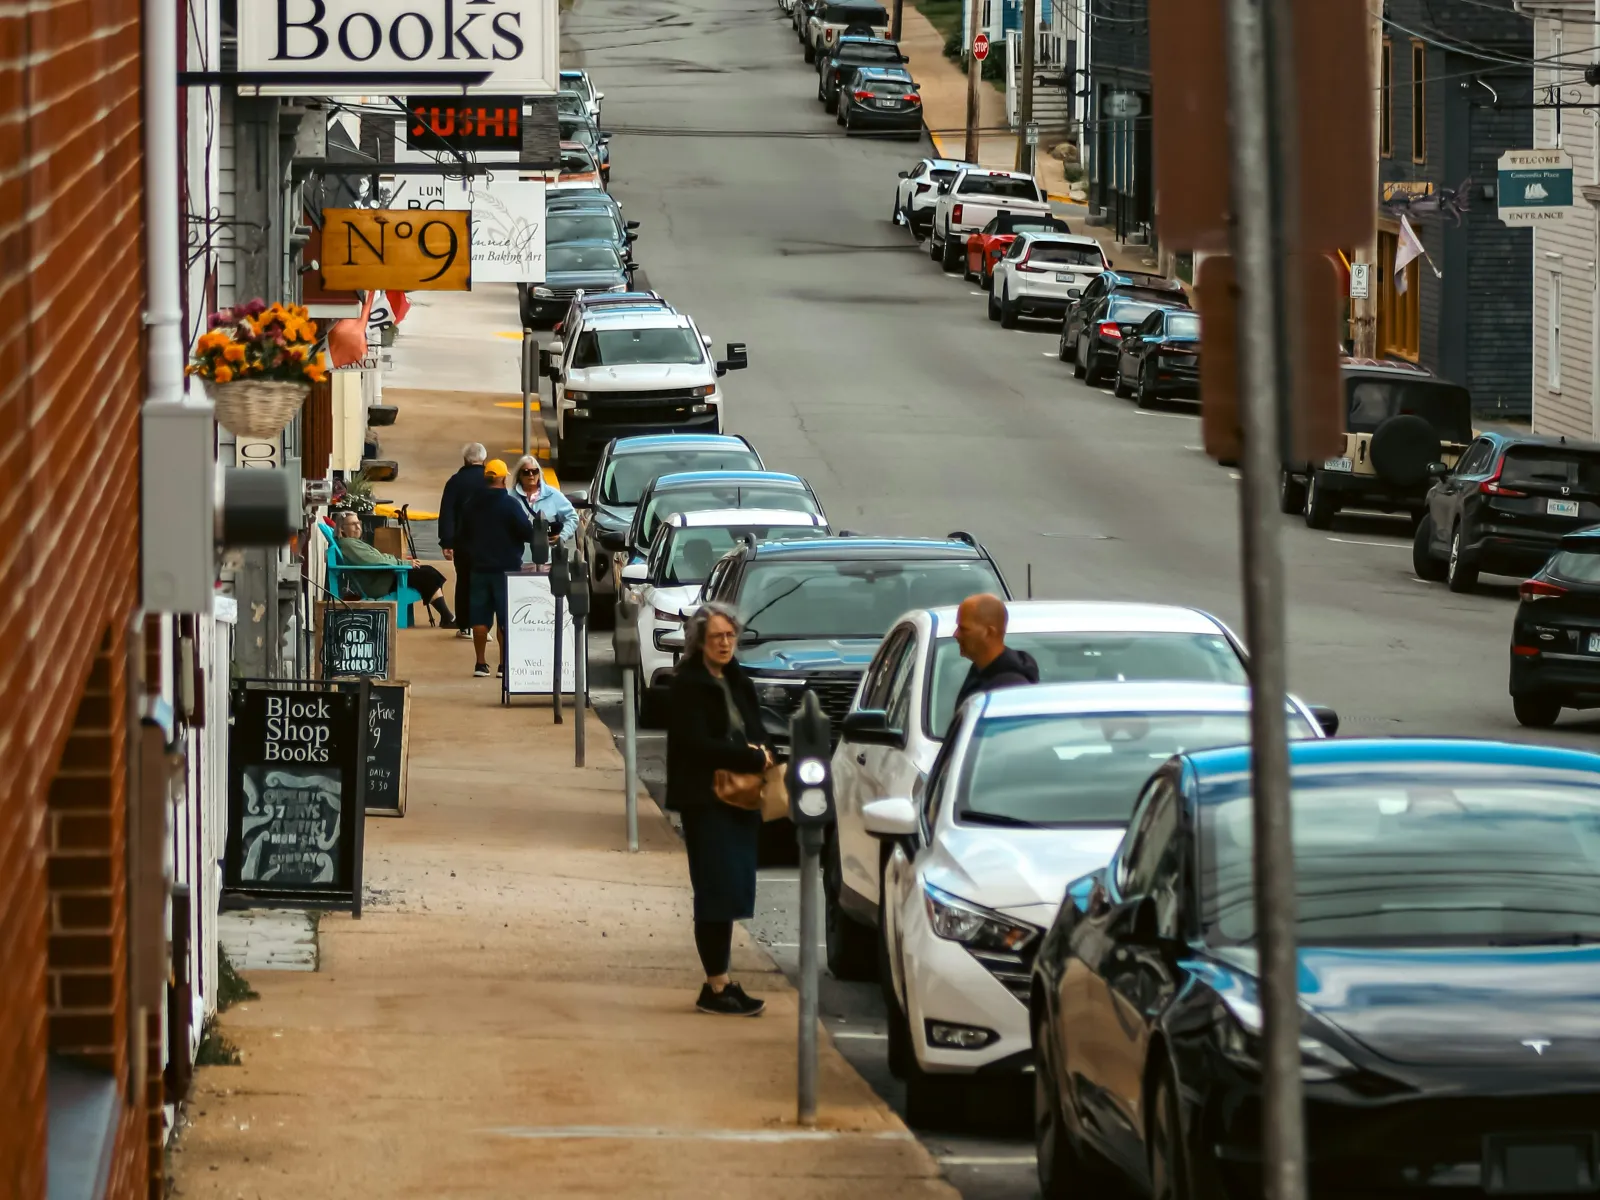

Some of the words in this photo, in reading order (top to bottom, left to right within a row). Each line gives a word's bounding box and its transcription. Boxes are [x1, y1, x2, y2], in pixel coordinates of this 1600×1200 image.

[268, 0, 524, 61] Books
[974, 42, 988, 52] STOP
[412, 106, 518, 137] SUSHI
[1510, 156, 1560, 165] WELCOME
[1509, 212, 1564, 220] ENTRANCE
[487, 251, 523, 264] Baking
[525, 252, 542, 261] Art
[347, 631, 366, 643] OLD
[343, 643, 373, 660] TOWN
[511, 667, 528, 676] 7:00
[525, 659, 544, 671] Wed.
[266, 696, 331, 719] Block
[266, 717, 330, 749] Shop
[264, 741, 329, 762] Books
[369, 768, 391, 779] DAILY
[275, 805, 286, 819] 7
